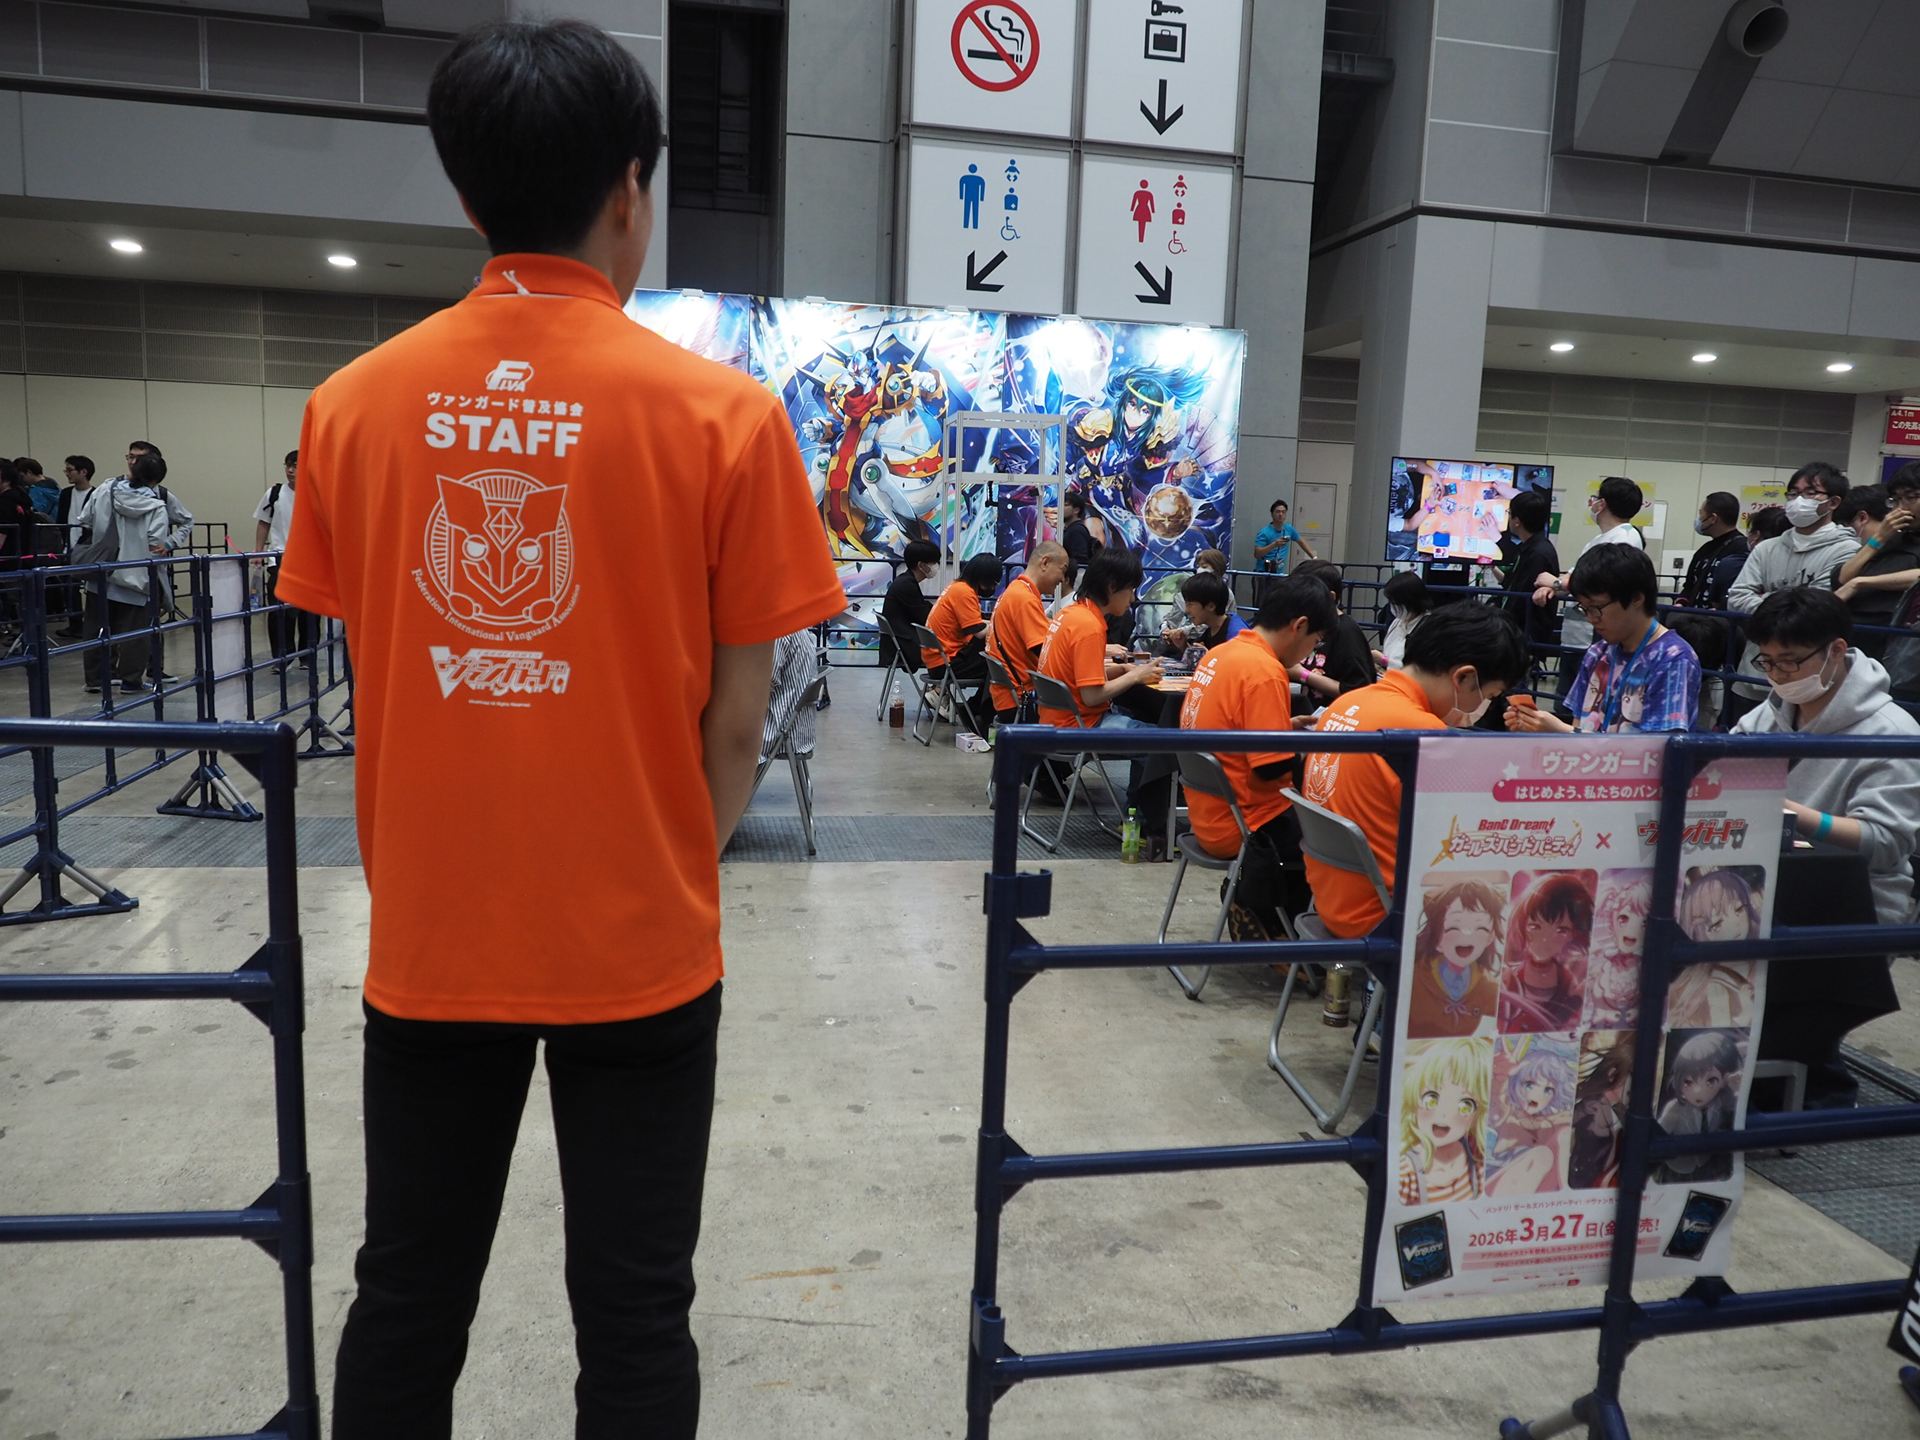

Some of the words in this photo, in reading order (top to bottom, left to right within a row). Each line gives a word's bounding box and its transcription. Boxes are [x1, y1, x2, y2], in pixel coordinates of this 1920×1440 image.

[424, 412, 583, 458] STAFF
[411, 567, 446, 615] Federation
[444, 611, 504, 641] International
[505, 624, 552, 642] Vanguard
